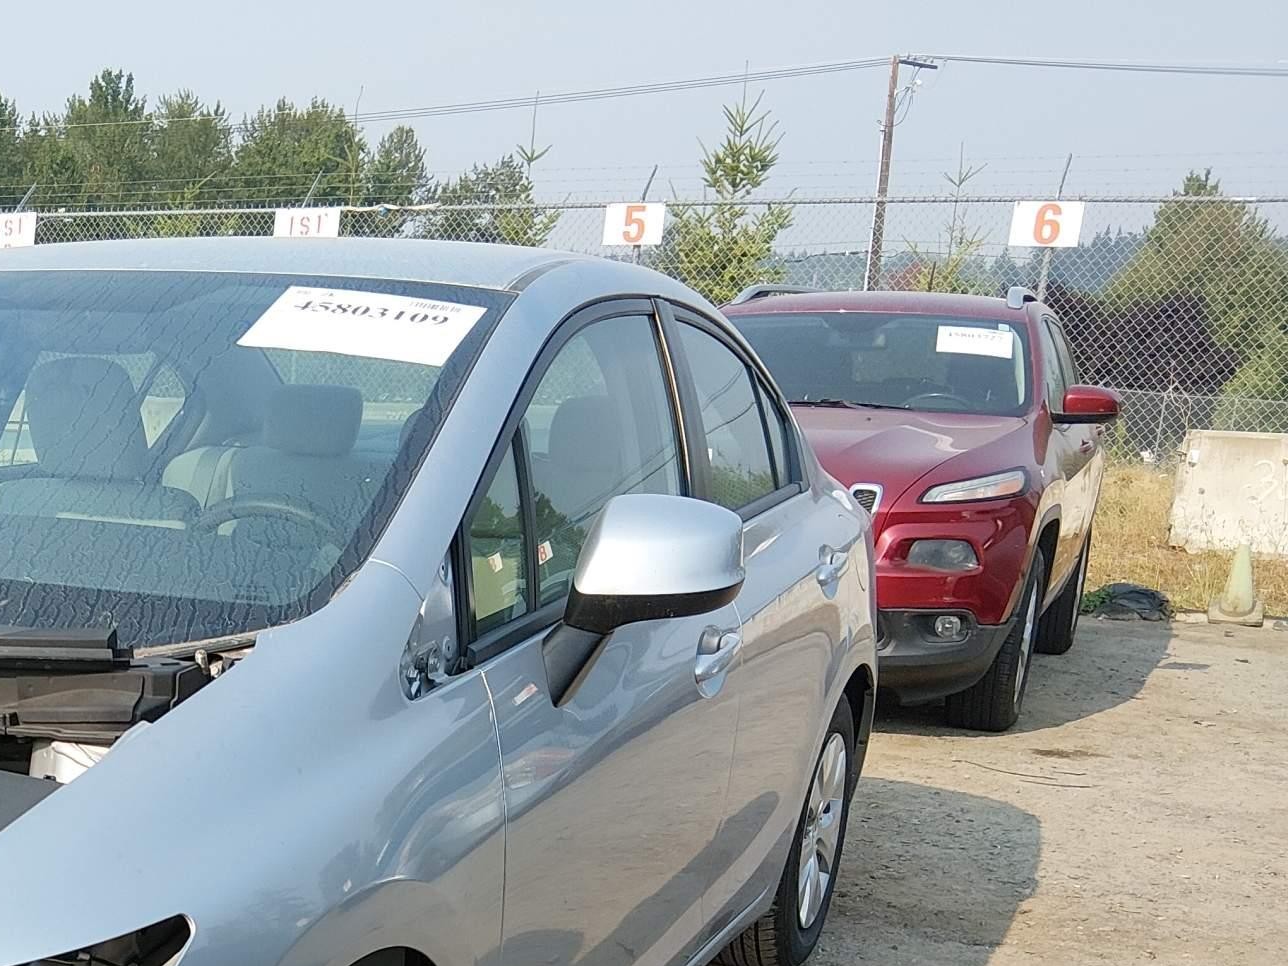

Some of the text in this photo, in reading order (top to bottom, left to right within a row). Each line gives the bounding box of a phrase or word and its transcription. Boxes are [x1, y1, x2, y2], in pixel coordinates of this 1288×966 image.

[622, 205, 647, 243] 5
[1033, 203, 1063, 245] 6
[294, 300, 448, 325] 45803109
